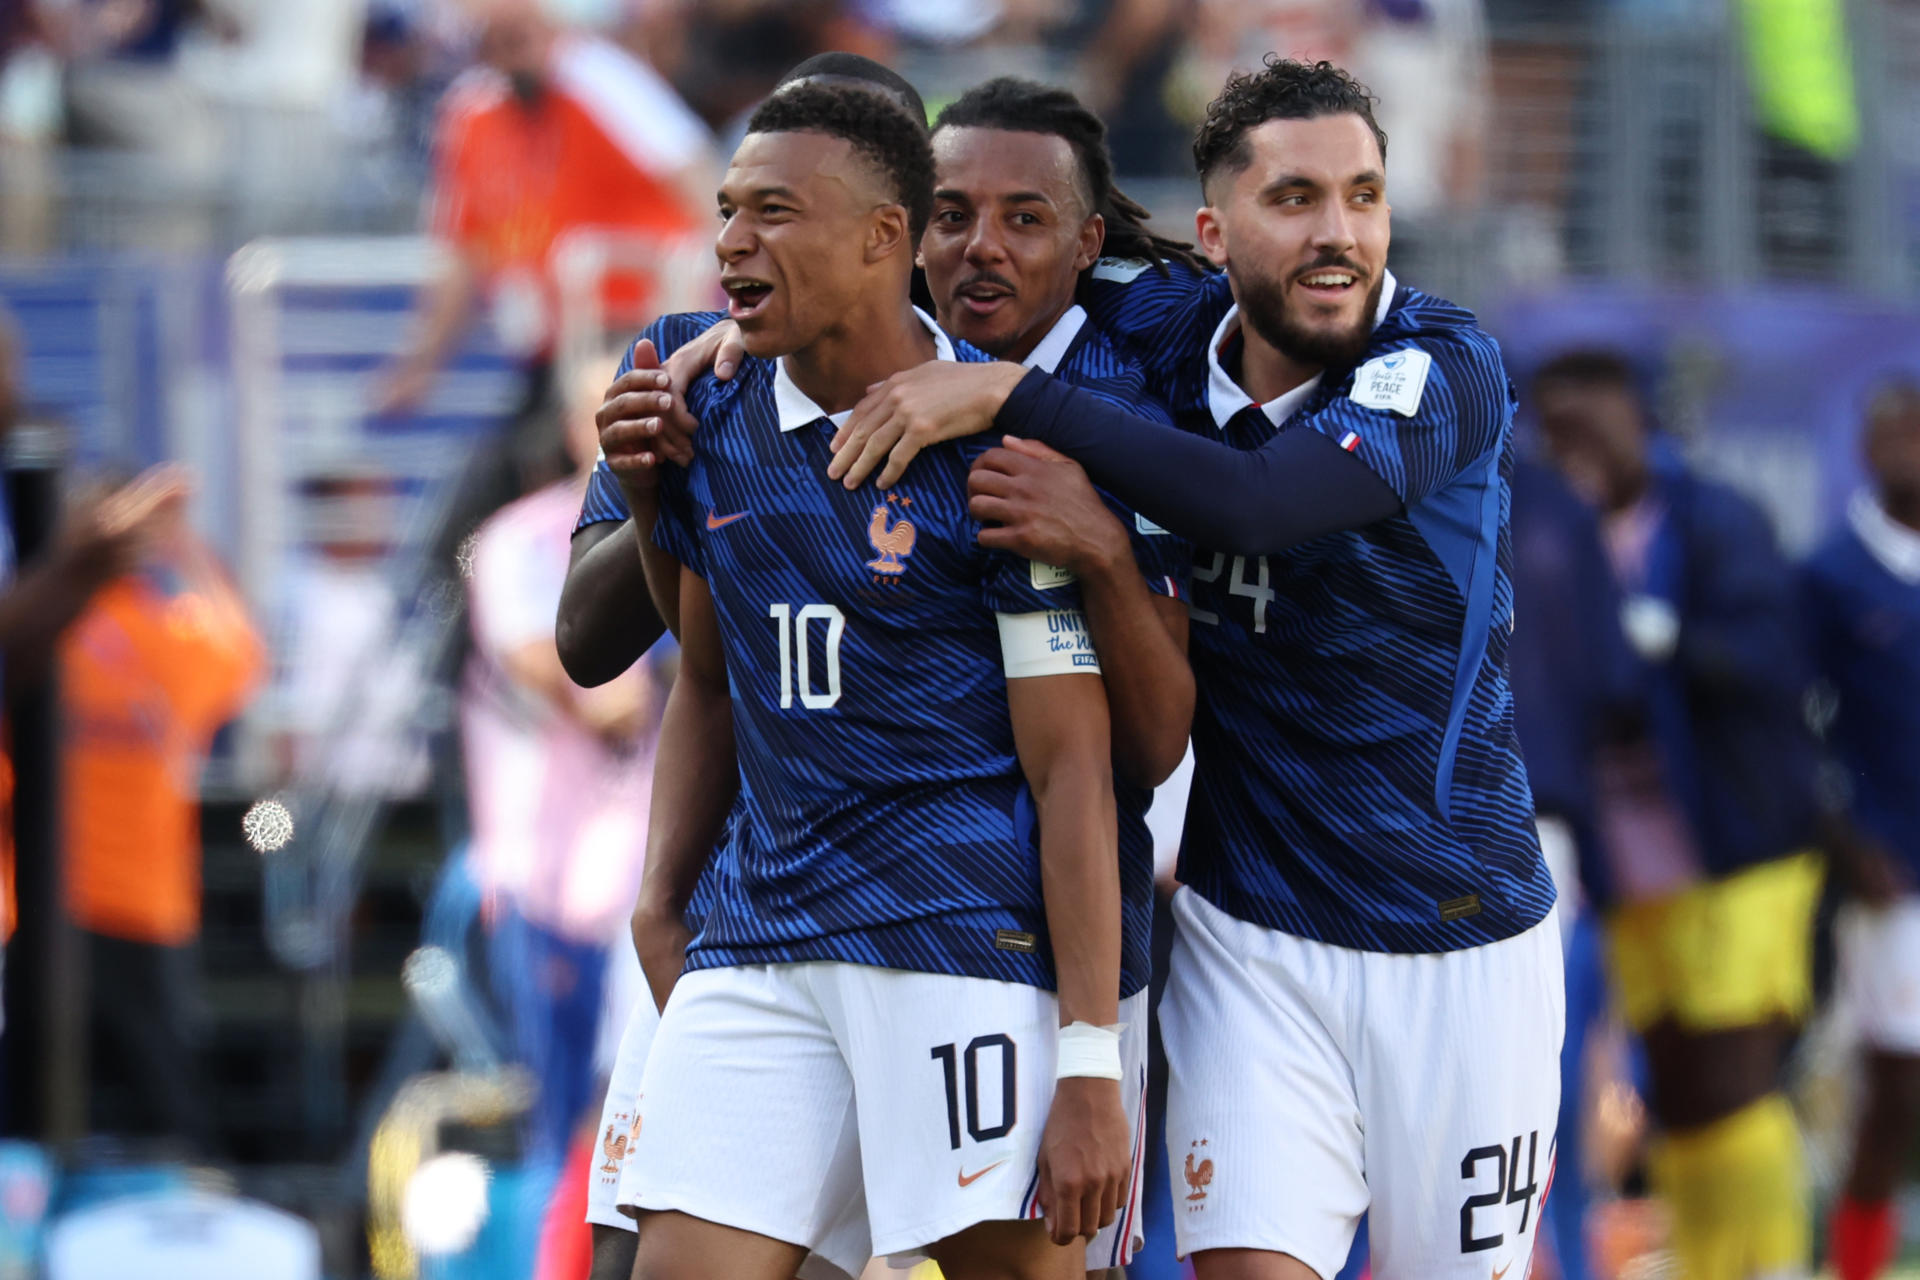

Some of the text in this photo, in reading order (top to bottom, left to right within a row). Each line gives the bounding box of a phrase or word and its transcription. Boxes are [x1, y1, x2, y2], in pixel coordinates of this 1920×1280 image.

[1370, 381, 1403, 395] PEACE
[769, 603, 845, 709] 10
[1047, 635, 1074, 652] the
[1074, 655, 1097, 665] FIFA
[930, 1033, 1017, 1150] 10
[1460, 1130, 1538, 1254] 24
